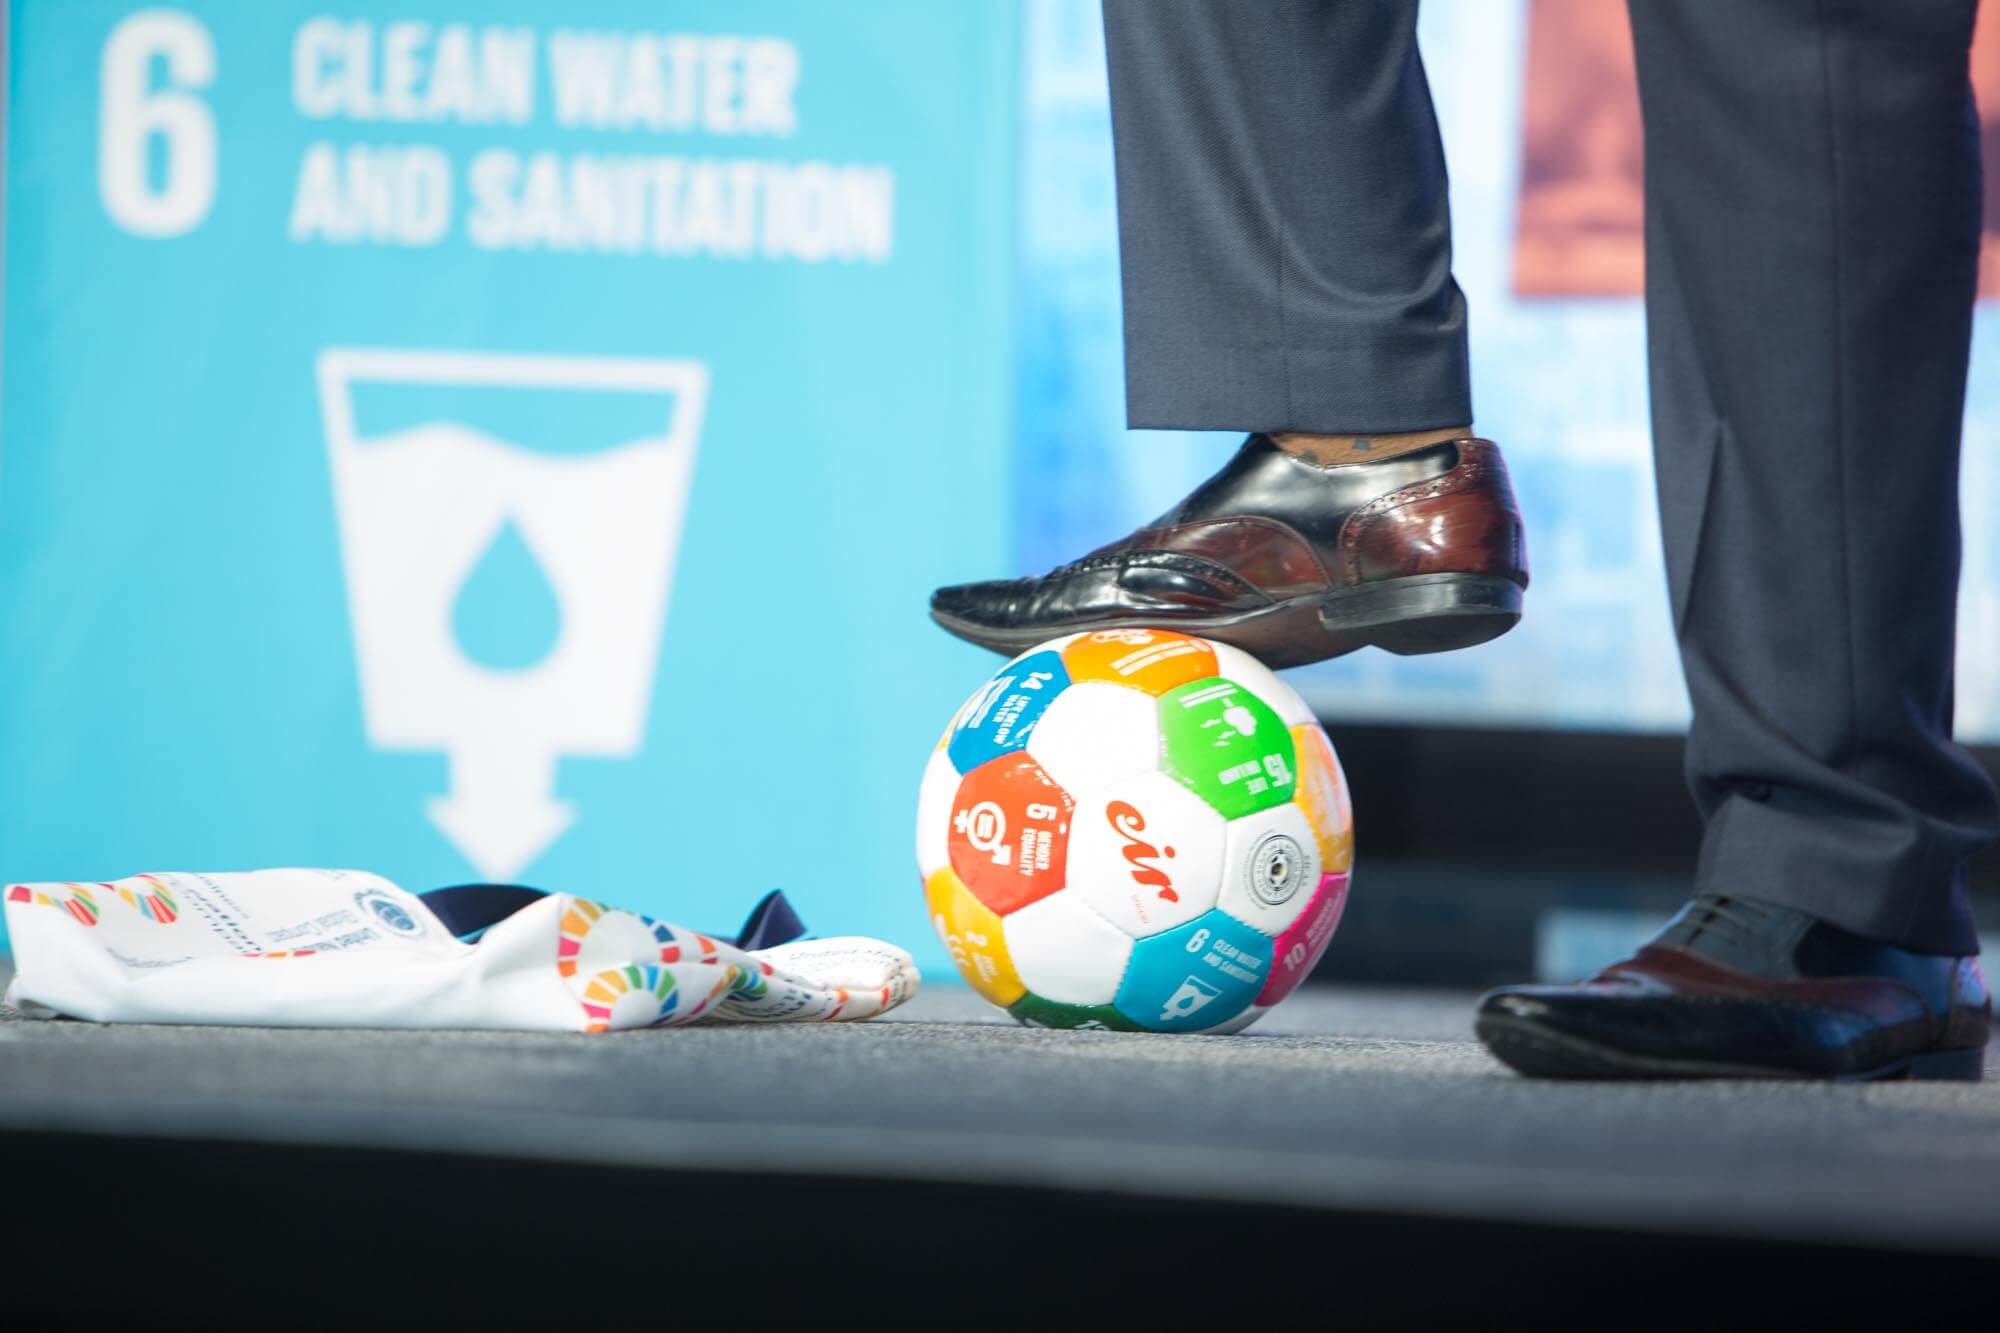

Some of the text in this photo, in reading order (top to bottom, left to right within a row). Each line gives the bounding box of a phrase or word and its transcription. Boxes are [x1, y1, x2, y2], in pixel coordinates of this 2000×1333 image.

[292, 18, 799, 138] CLEAN WATER
[98, 8, 217, 239] 6
[290, 143, 893, 264] AND SANITATION
[1020, 671, 1053, 690] 14
[1026, 803, 1057, 820] 5
[1020, 828, 1037, 876] EQUALITY
[1035, 831, 1053, 870] GENDER
[1106, 800, 1179, 903] eir
[1185, 928, 1211, 953] 6
[1283, 942, 1307, 971] 10
